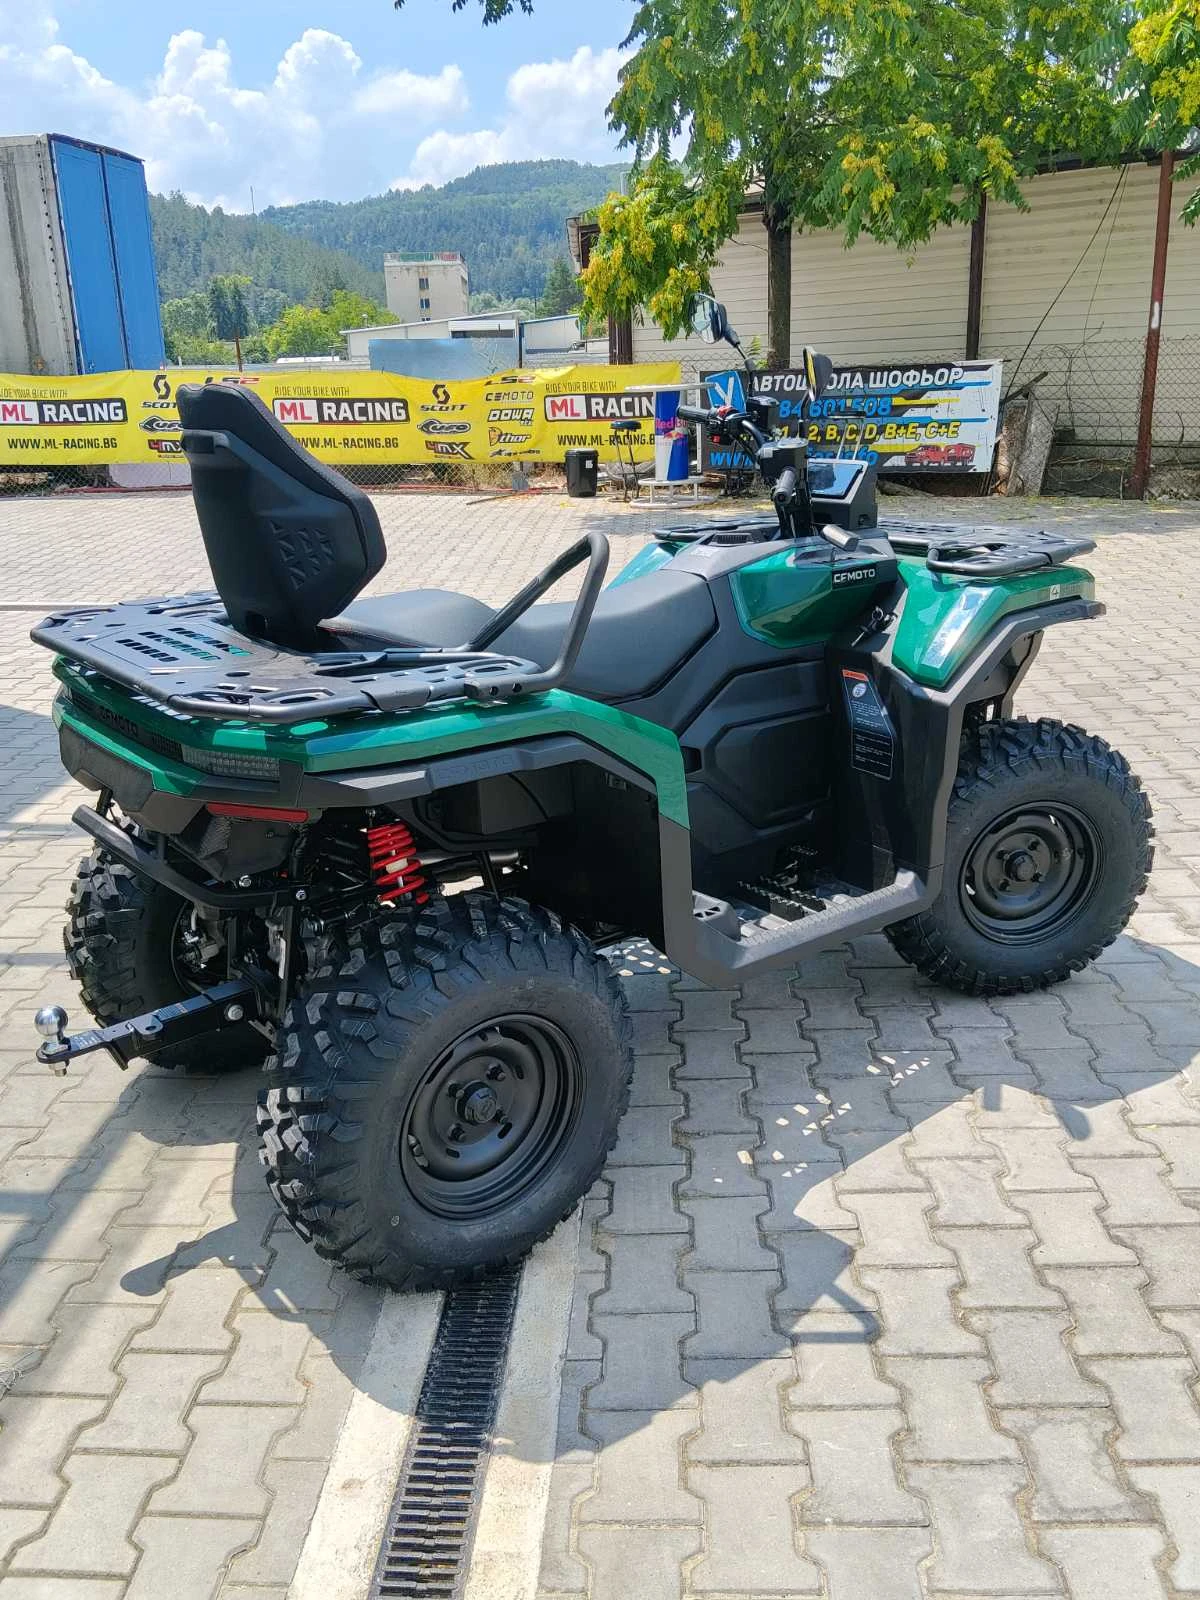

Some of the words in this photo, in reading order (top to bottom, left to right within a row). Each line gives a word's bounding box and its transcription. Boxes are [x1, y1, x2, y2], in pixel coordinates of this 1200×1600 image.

[869, 368, 964, 388] ШОФЬОР
[274, 386, 290, 396] RIDE
[292, 386, 312, 396] YOUR
[313, 386, 329, 396] BIKE
[330, 386, 350, 397] WITH
[582, 381, 598, 392] BIKE
[599, 380, 617, 391] WITH
[49, 389, 68, 398] WITH
[142, 401, 177, 409] SCOT
[420, 404, 467, 412] SCOTT
[550, 398, 582, 418] ML
[590, 396, 655, 418] RACIN
[1, 403, 33, 422] ML
[42, 402, 124, 422] RACING
[279, 402, 313, 420] ML
[322, 402, 407, 421] RACING
[8, 438, 118, 449] WWW.ML-RACING.BG
[558, 434, 655, 446] WWW.ML-RACING.B
